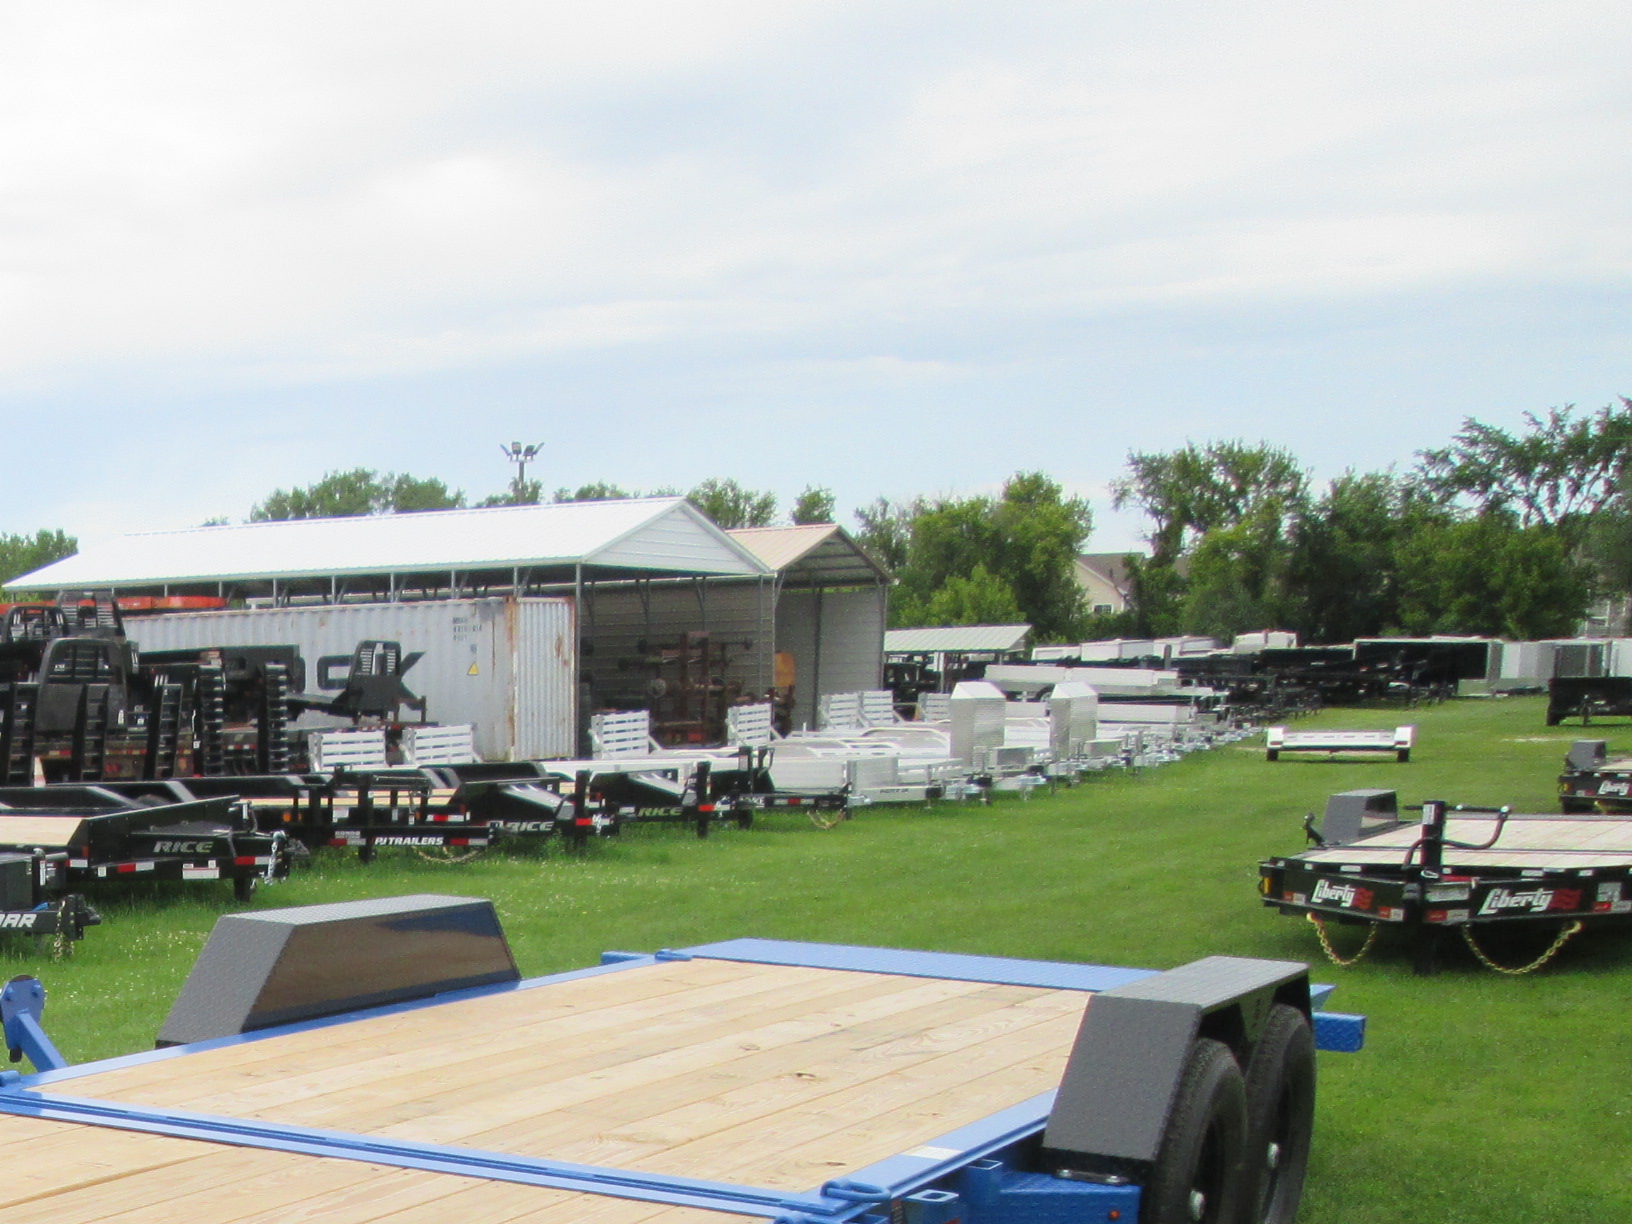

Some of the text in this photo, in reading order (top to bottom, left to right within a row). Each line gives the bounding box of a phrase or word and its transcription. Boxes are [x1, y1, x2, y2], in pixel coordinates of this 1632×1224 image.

[637, 806, 683, 817] RICE
[504, 821, 554, 832] RICE
[374, 836, 444, 845] PJ TRAILERS
[153, 841, 214, 853] RICE
[1310, 879, 1356, 907] Liberty
[1477, 888, 1555, 916] Liberty
